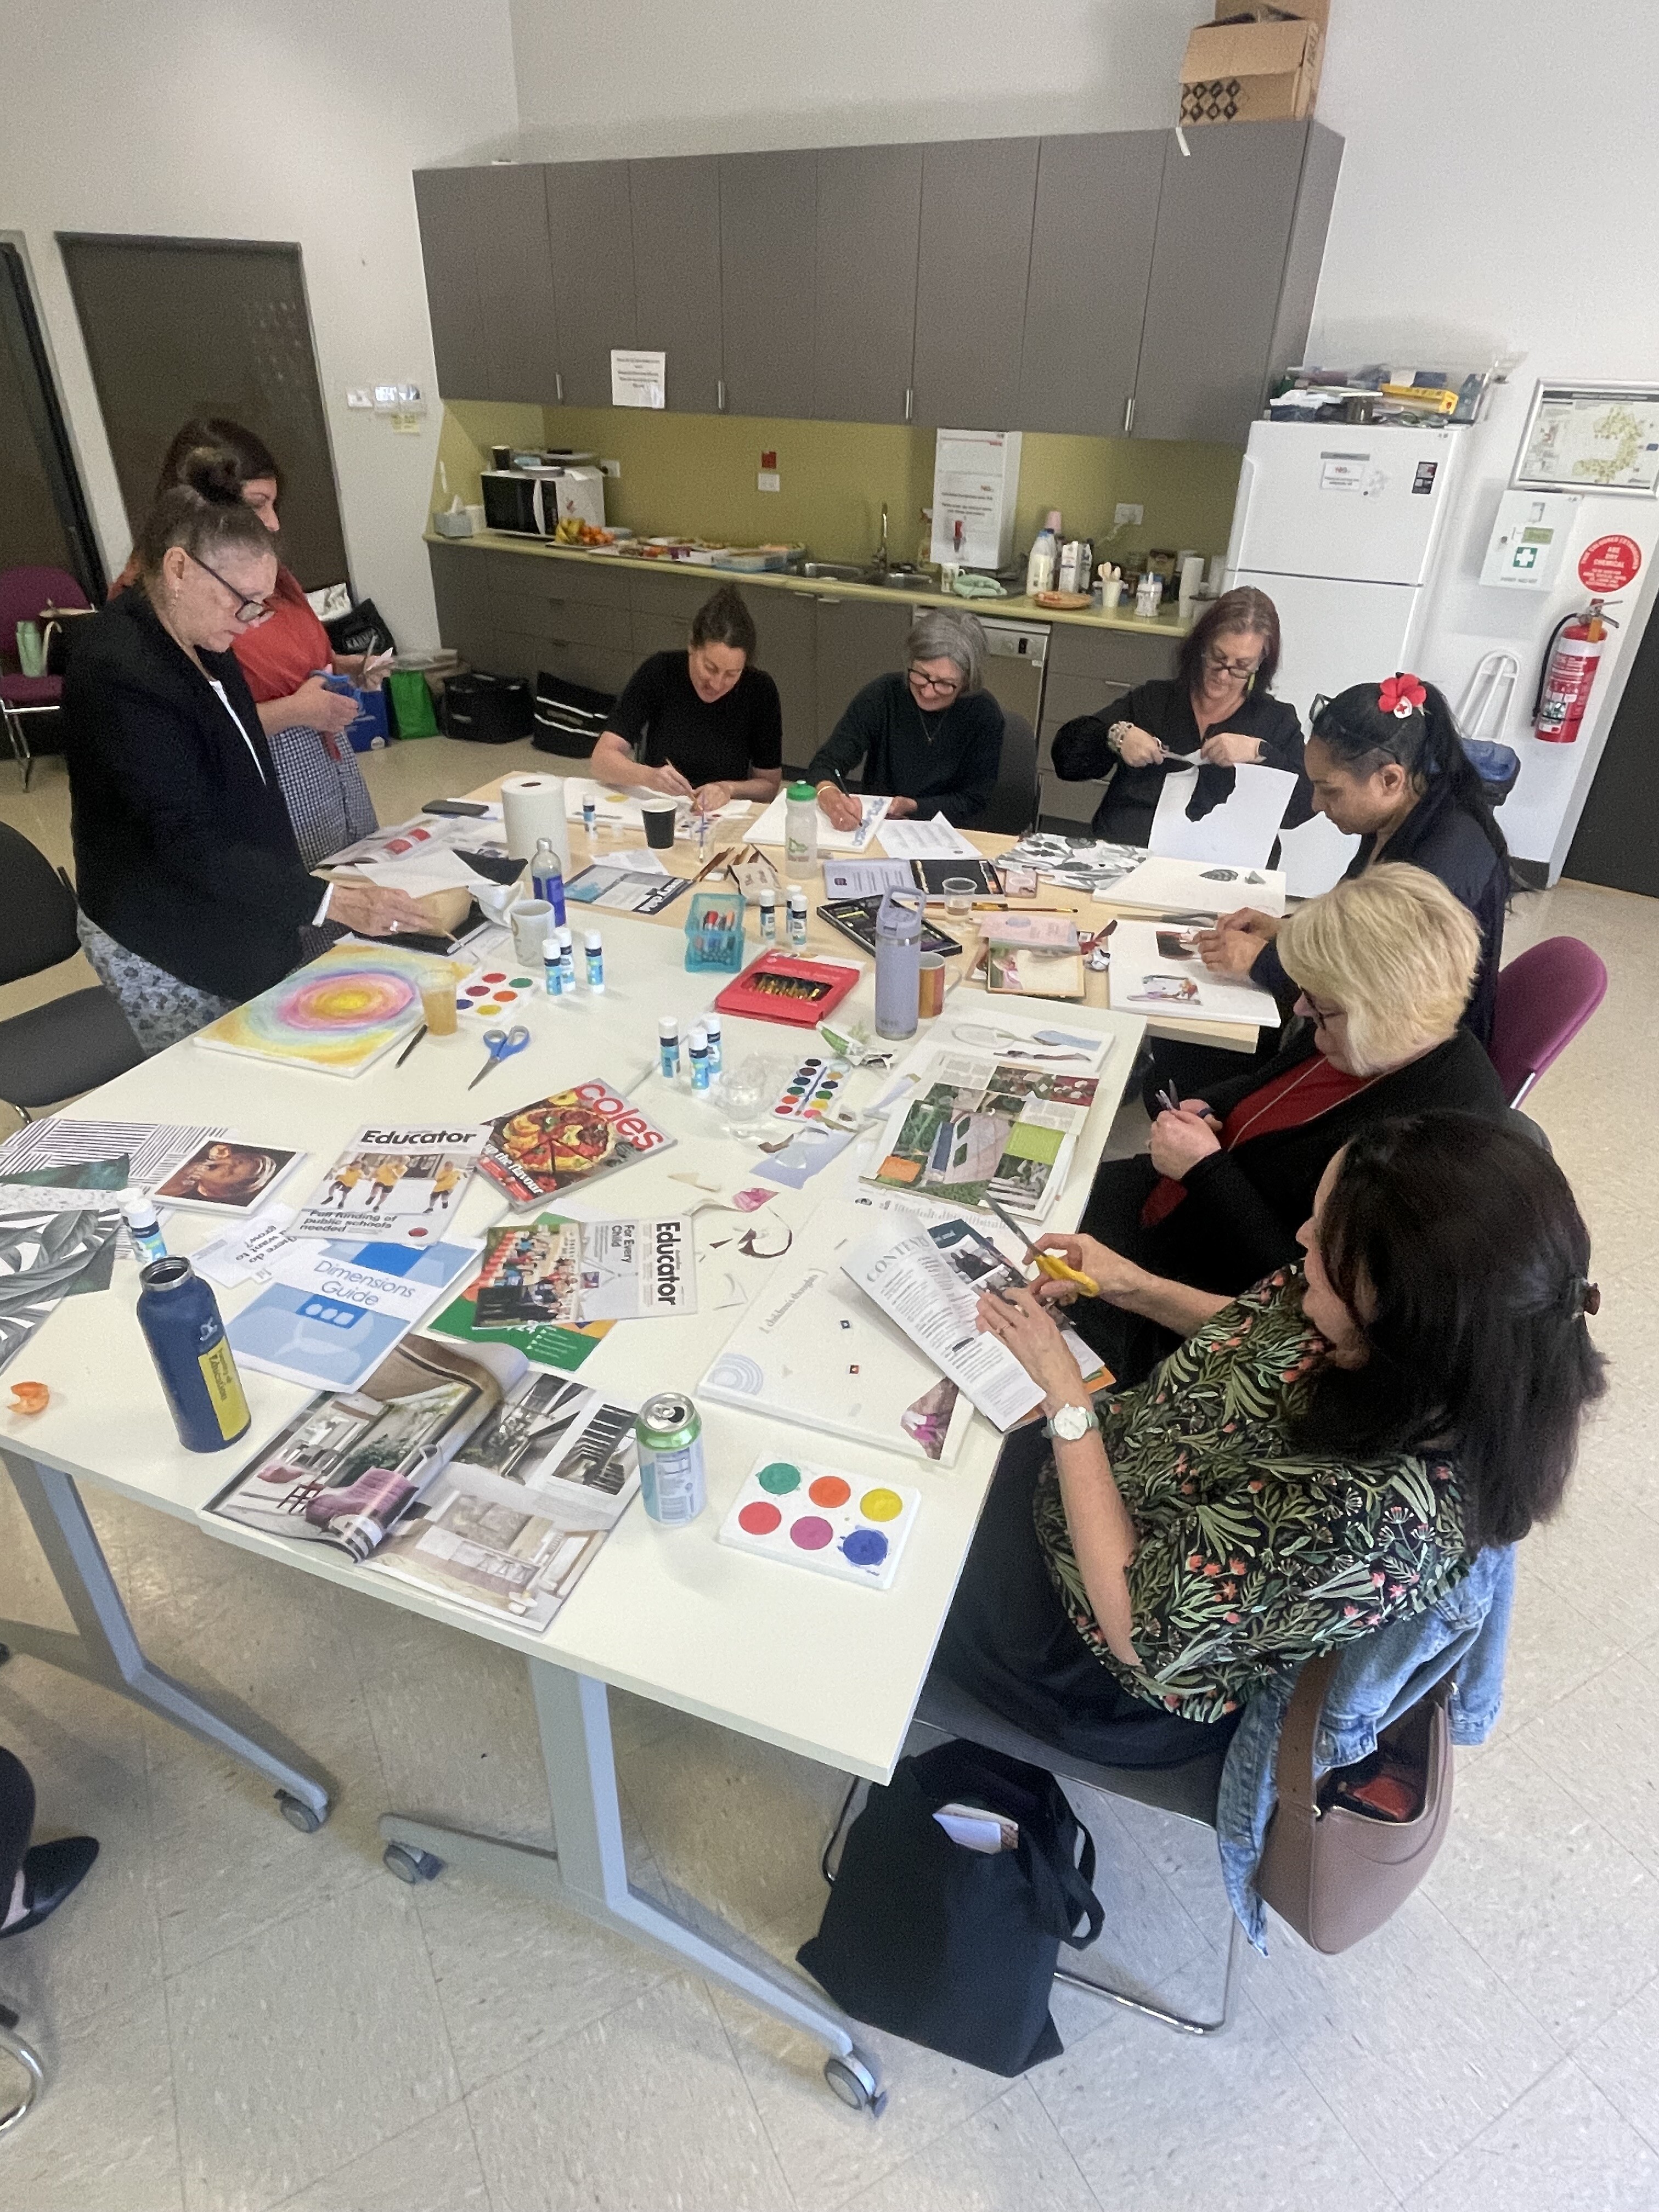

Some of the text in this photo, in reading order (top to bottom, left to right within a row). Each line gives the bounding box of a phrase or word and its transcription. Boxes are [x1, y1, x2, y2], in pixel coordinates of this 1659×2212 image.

[574, 1083, 664, 1152] coles
[360, 1130, 477, 1144] Educator
[495, 1152, 512, 1165] the
[508, 1163, 544, 1194] flavour
[335, 1211, 381, 1221] funding
[346, 1220, 392, 1228] schools
[611, 1225, 623, 1248] Child
[621, 1224, 635, 1263] For Every
[314, 1260, 416, 1298] Dimensions
[656, 1221, 681, 1306] Educator
[321, 1280, 379, 1306] Guide
